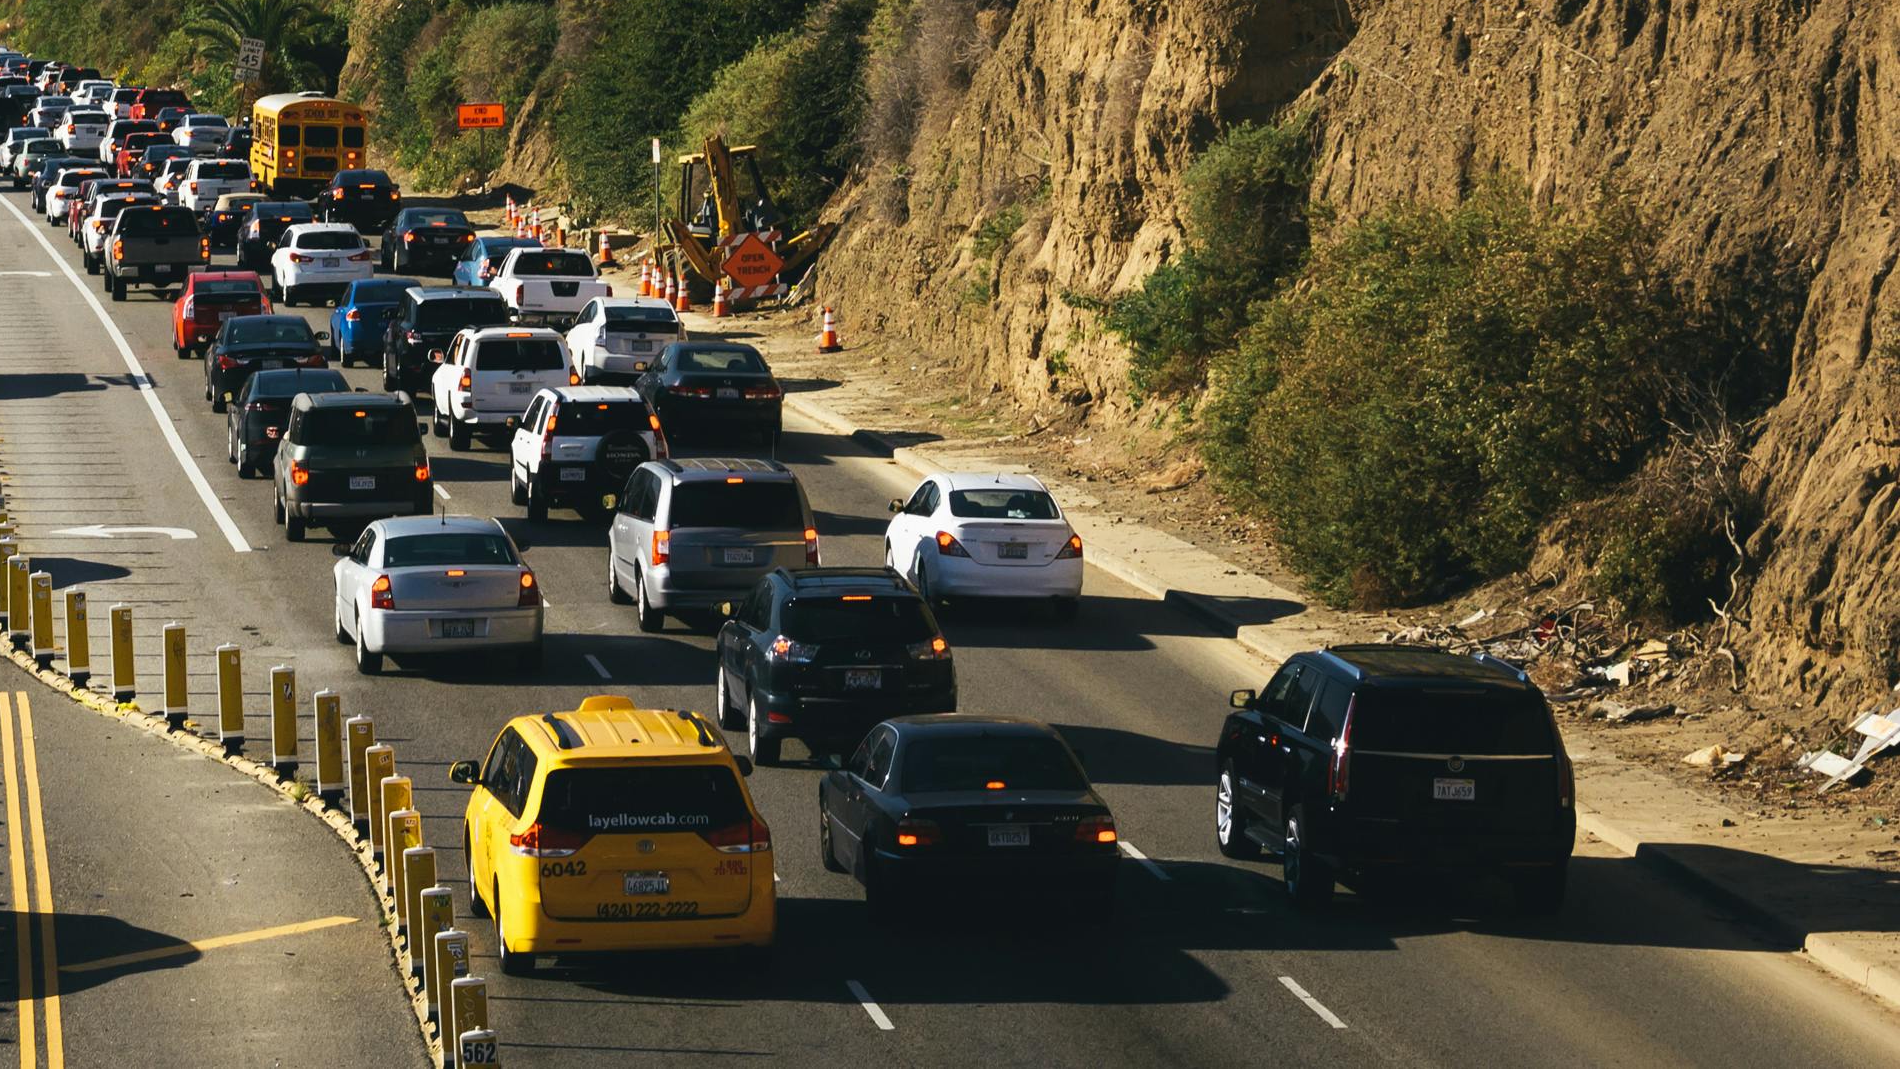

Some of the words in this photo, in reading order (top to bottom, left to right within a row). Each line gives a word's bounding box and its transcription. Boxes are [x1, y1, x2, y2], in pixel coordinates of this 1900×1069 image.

[243, 38, 265, 48] SPEED
[241, 54, 259, 67] 45
[303, 109, 324, 118] SCHOOL
[327, 109, 340, 118] BUS
[741, 253, 765, 262] OPEN
[737, 266, 771, 275] TRENCH
[606, 451, 641, 459] HONDA
[588, 812, 709, 829] layellowcab.com
[541, 860, 587, 878] 6042
[596, 903, 633, 917] (424)
[635, 901, 699, 916] 222-2222
[462, 1042, 496, 1064] 562
